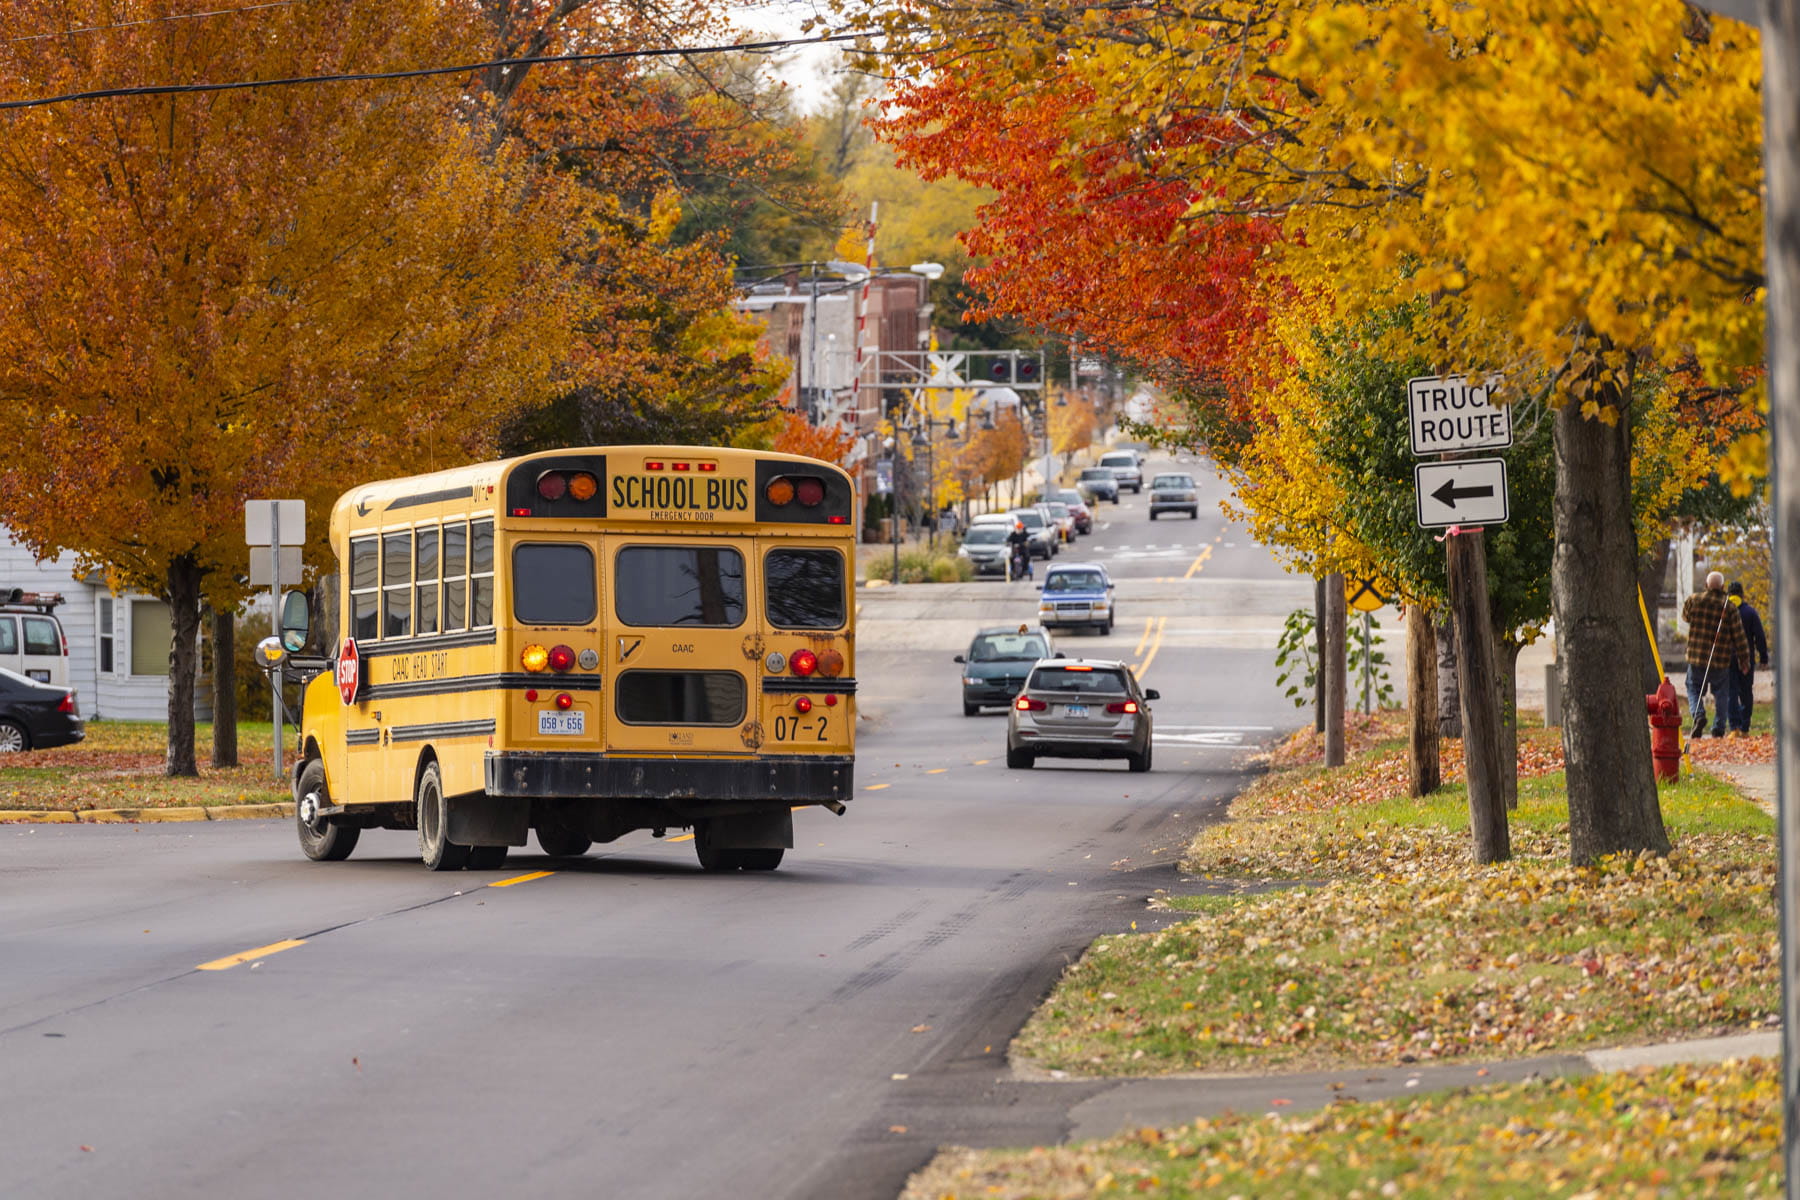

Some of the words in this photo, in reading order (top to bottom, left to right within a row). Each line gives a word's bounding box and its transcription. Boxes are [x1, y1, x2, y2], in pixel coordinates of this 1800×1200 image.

[1416, 384, 1499, 412] TRUCK
[1421, 414, 1504, 443] ROUTE
[613, 476, 700, 509] SCHOOL
[707, 478, 748, 511] BUS
[650, 510, 692, 521] EMERGENCY
[694, 511, 714, 521] DOOR
[672, 643, 694, 654] CAAC
[340, 659, 357, 684] STOP
[392, 657, 410, 681] CAAC
[413, 655, 428, 679] HEAD
[431, 652, 448, 677] START
[567, 717, 582, 730] 656
[775, 716, 828, 741] 07-2
